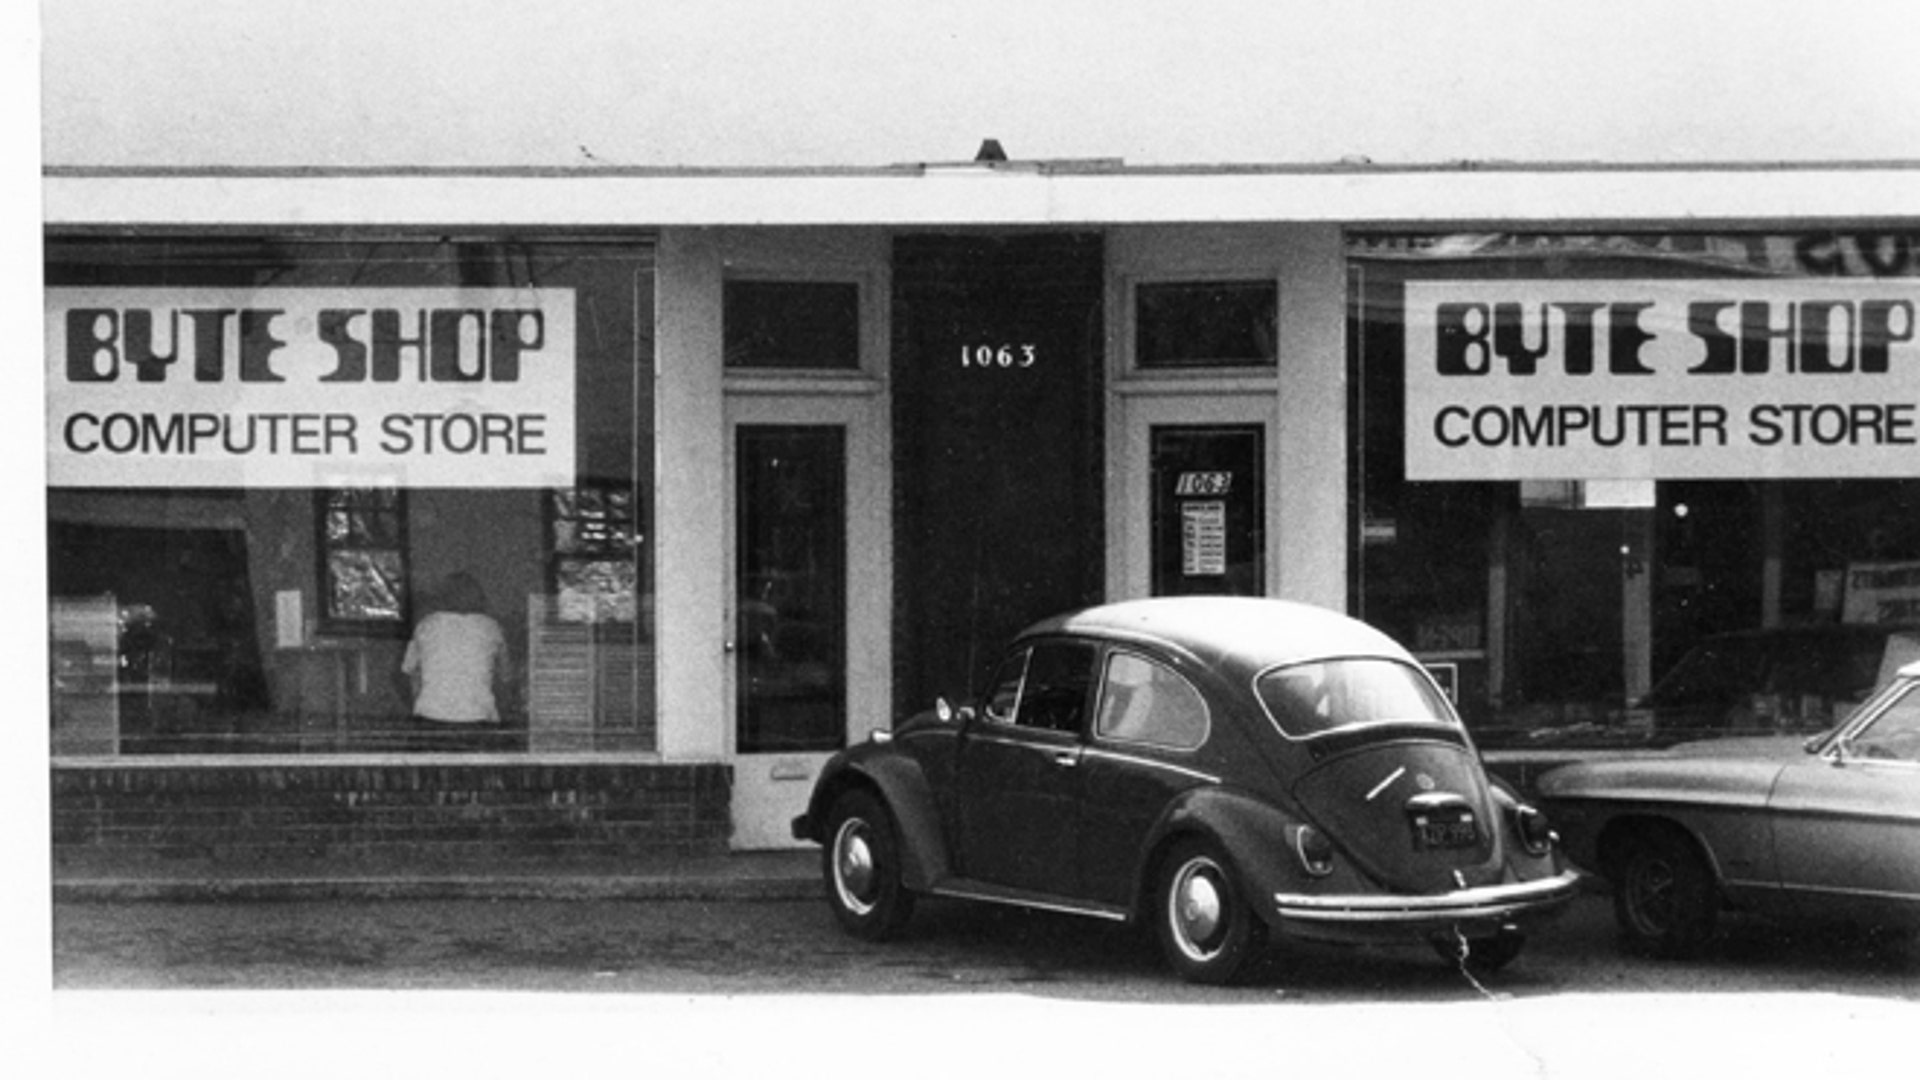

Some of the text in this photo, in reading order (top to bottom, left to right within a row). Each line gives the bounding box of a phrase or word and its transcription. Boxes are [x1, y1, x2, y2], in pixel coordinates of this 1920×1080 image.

[65, 307, 545, 383] BYTE SHOP
[961, 344, 1036, 368] 1063
[1435, 299, 1915, 377] BYTE SHOP
[63, 412, 546, 455] COMPUTER STORE
[1434, 402, 1917, 448] COMPUTER STORE
